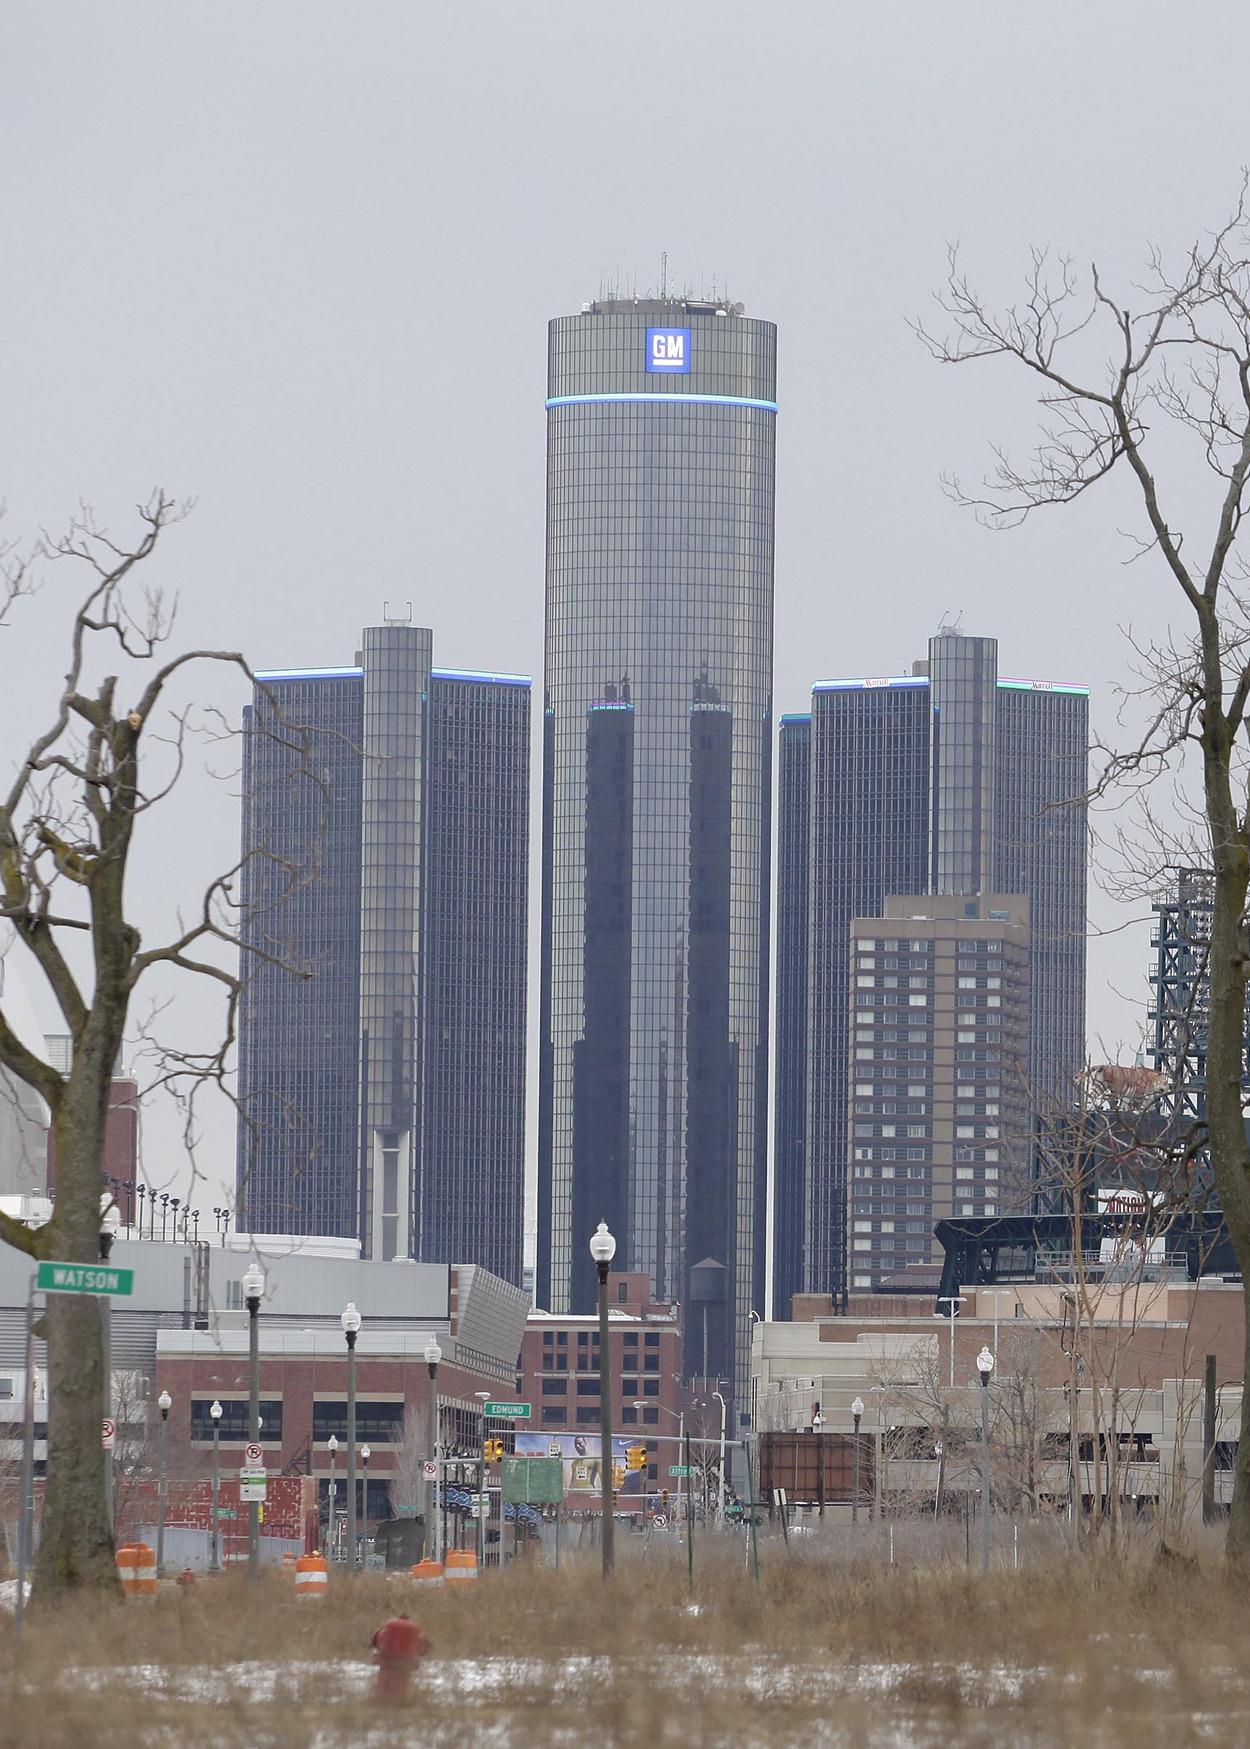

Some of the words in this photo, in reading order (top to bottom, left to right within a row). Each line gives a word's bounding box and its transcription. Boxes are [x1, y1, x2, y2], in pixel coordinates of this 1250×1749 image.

[652, 334, 684, 359] GM
[53, 1268, 119, 1290] WATSON
[491, 1404, 525, 1416] EDMUND
